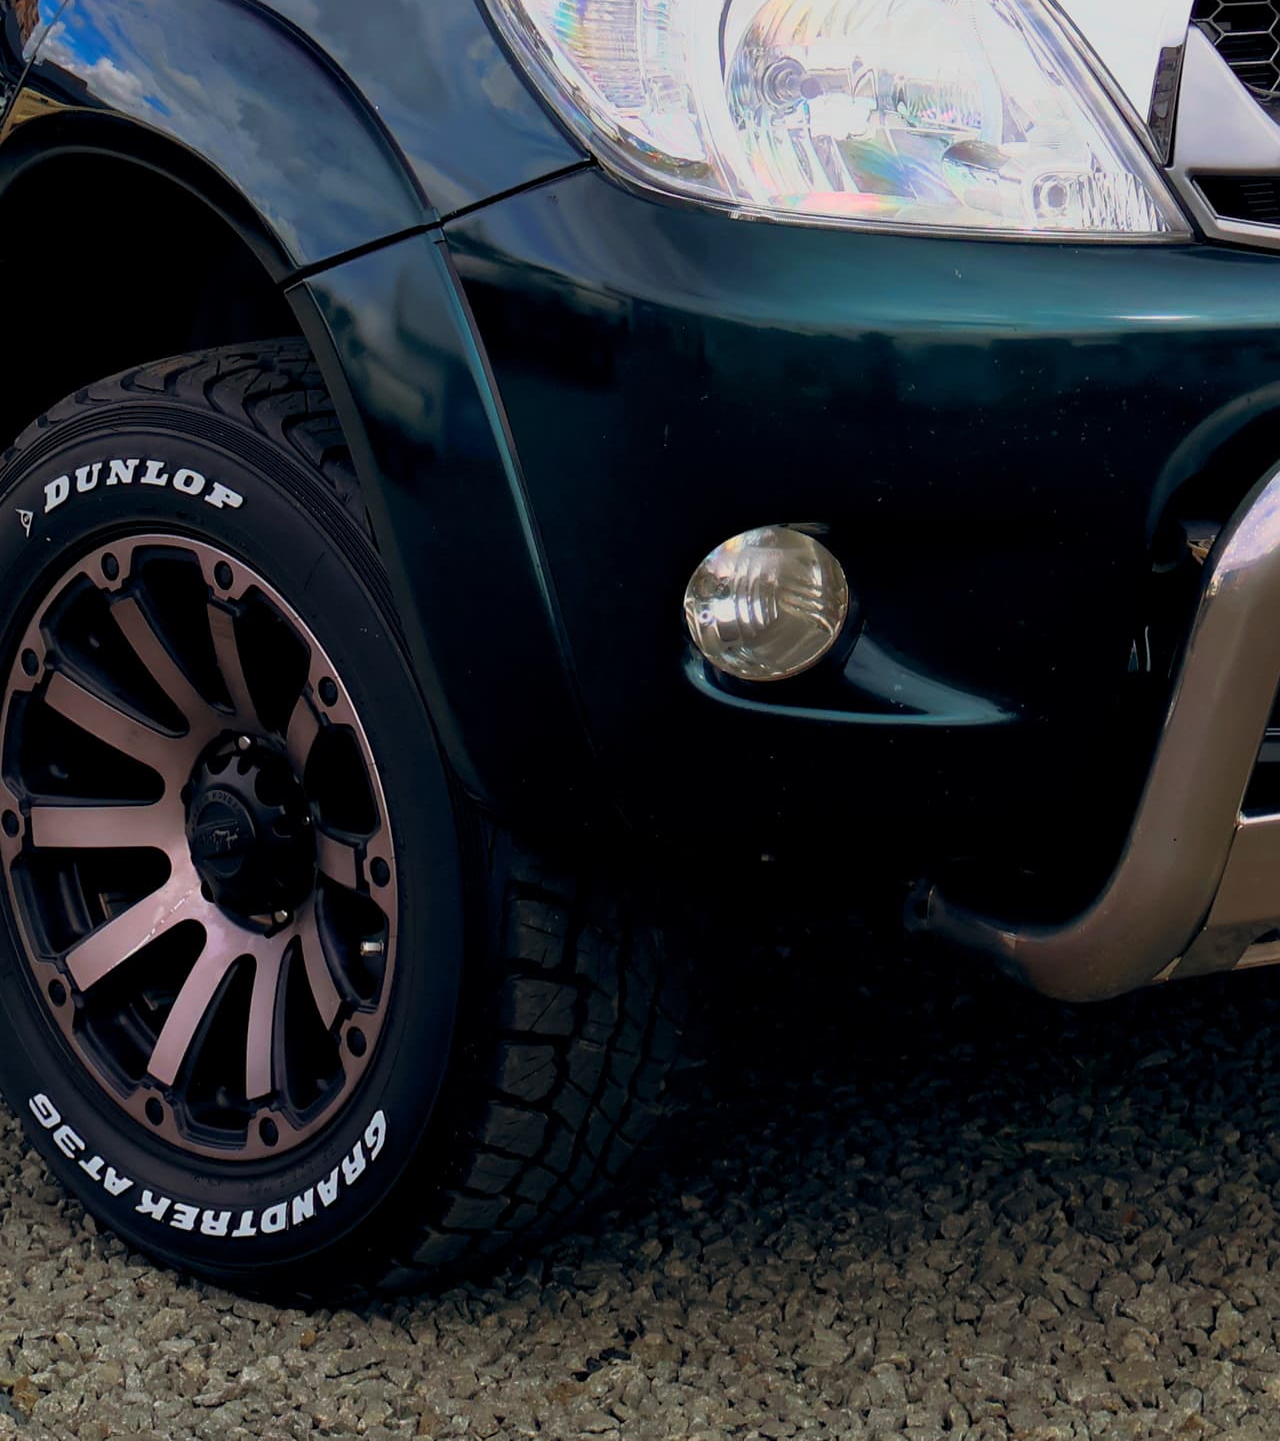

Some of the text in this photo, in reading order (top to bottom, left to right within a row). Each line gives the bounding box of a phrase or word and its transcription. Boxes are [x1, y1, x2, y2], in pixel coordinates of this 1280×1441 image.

[43, 458, 243, 513] DUNLOP
[29, 1093, 386, 1237] GRANDTREK AT3G
